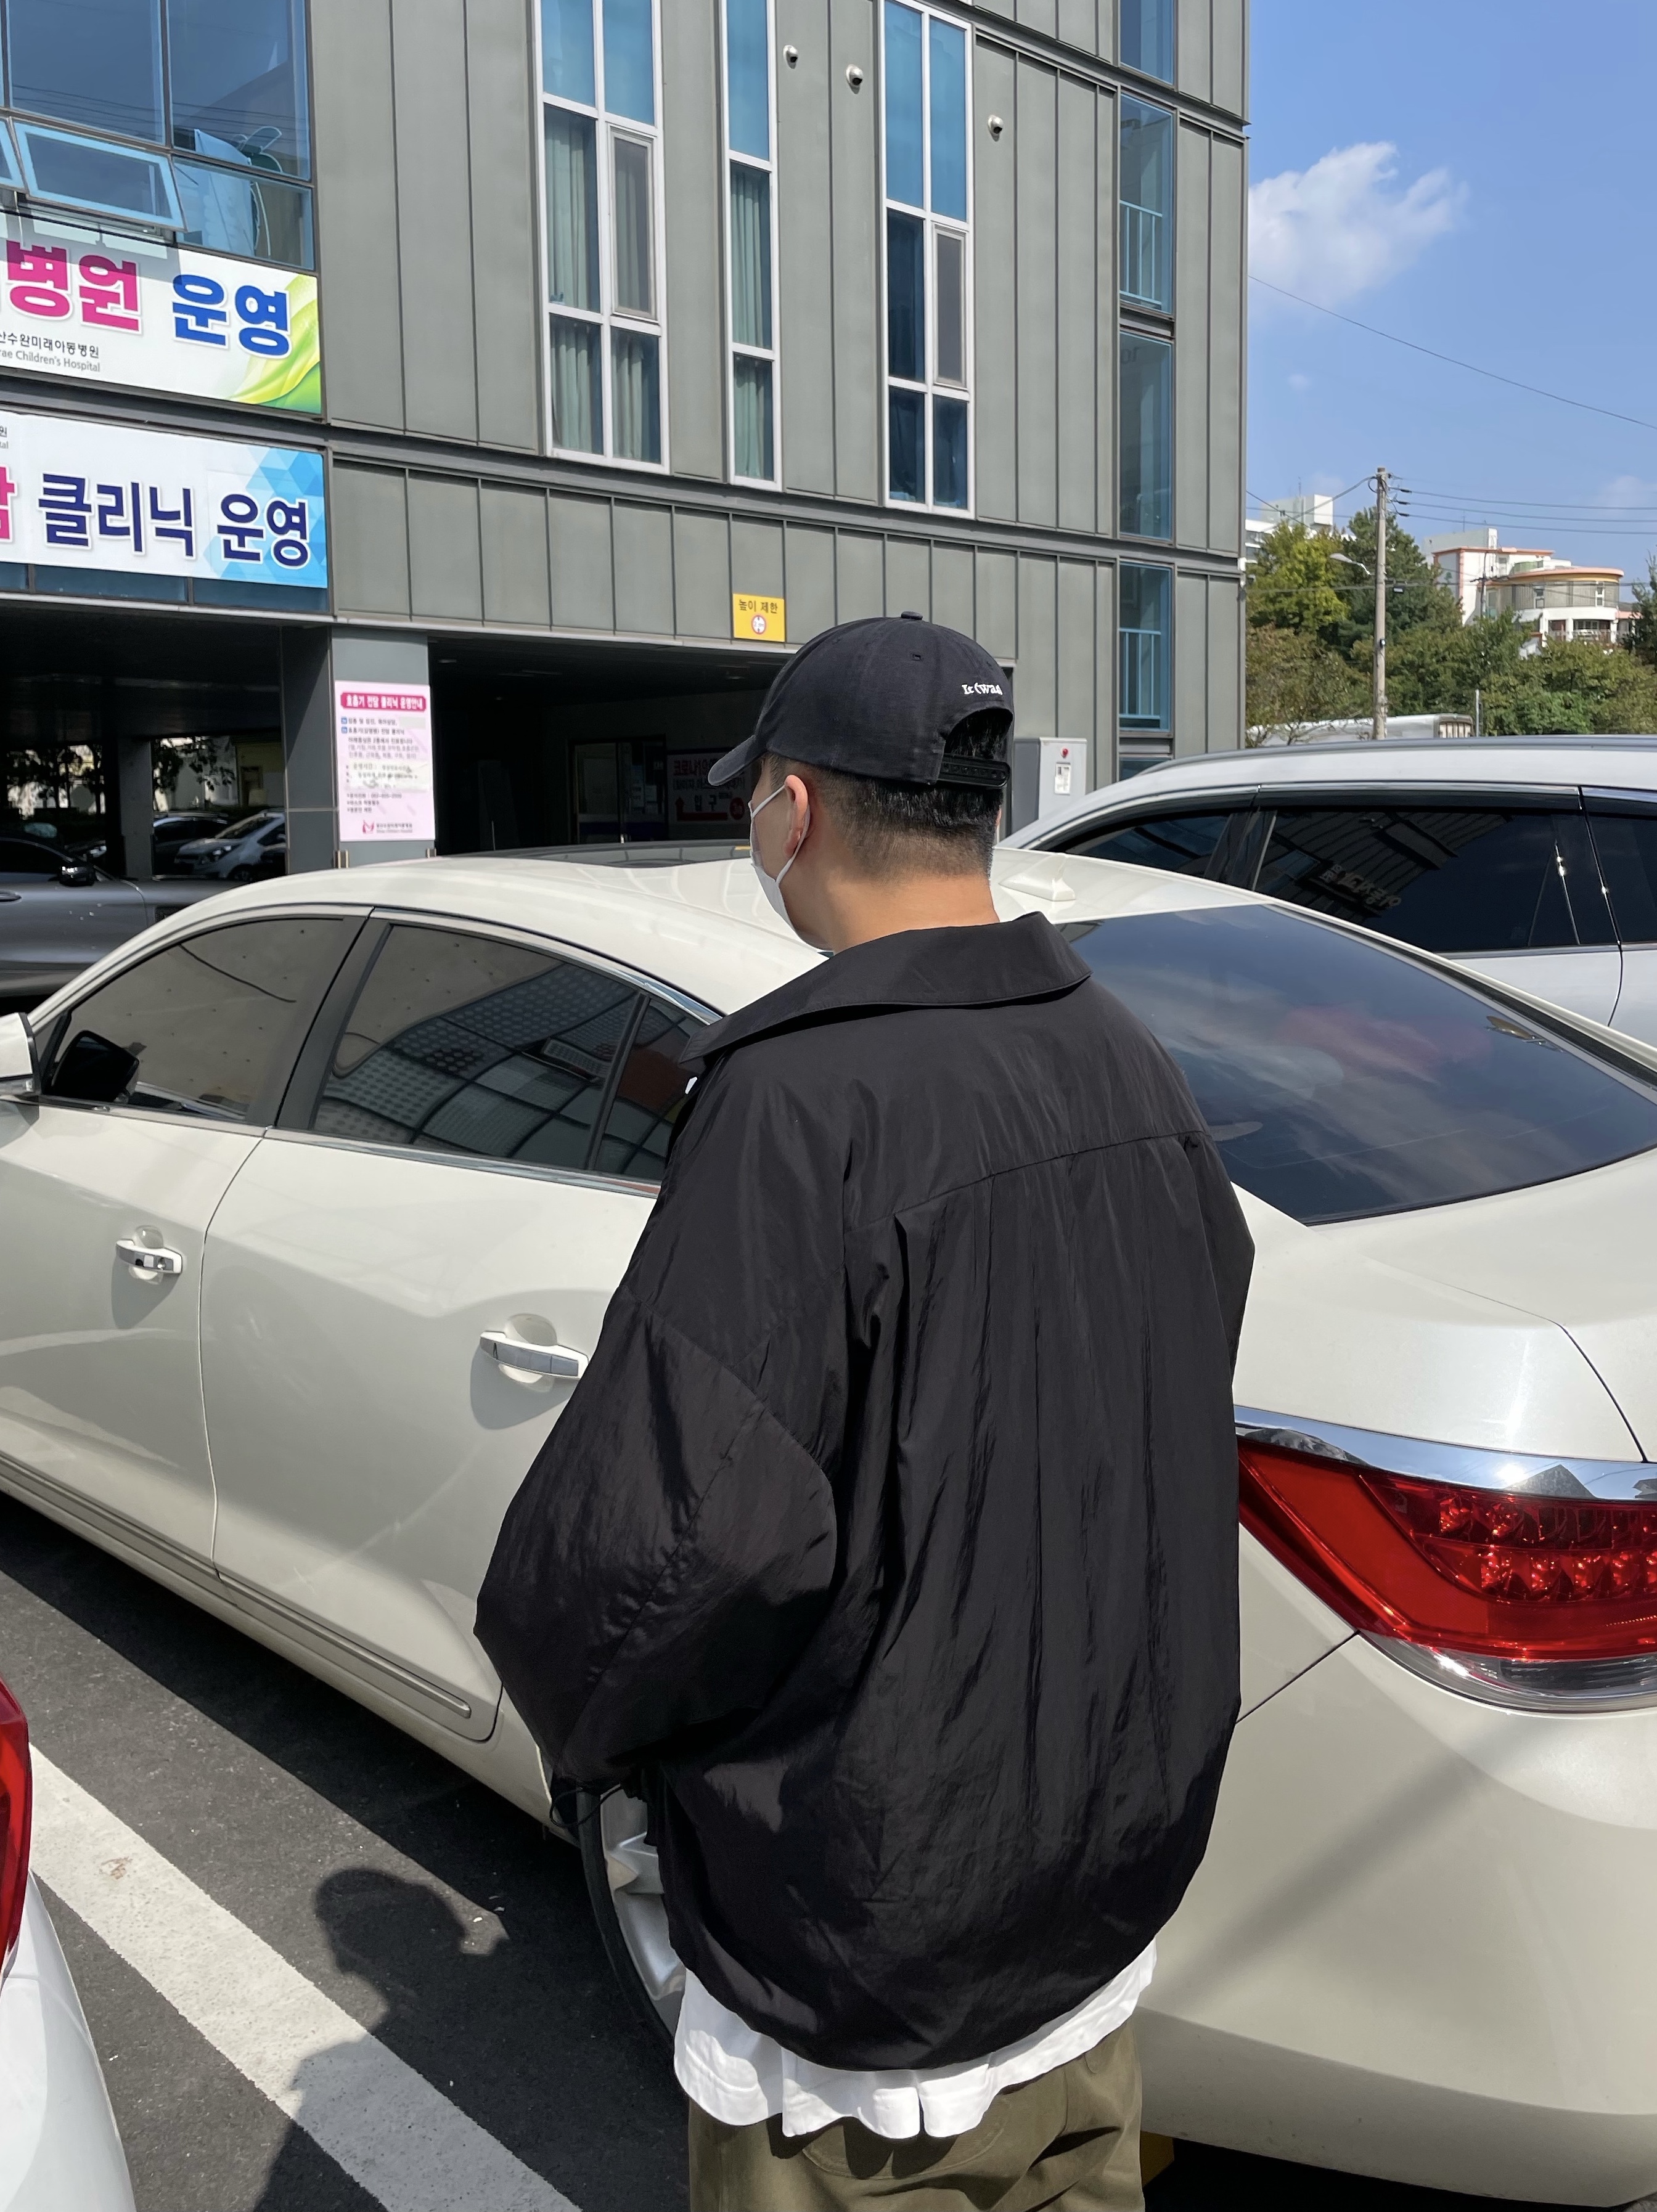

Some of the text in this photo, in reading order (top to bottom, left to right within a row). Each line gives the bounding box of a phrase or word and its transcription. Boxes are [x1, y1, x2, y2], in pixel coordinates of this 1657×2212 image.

[6, 240, 290, 356] 병원 운영
[15, 350, 61, 366] Children's
[63, 357, 100, 372] Hospital
[38, 473, 194, 557] 클리닉
[217, 494, 309, 566] 운영
[738, 599, 778, 614] 높이 제한
